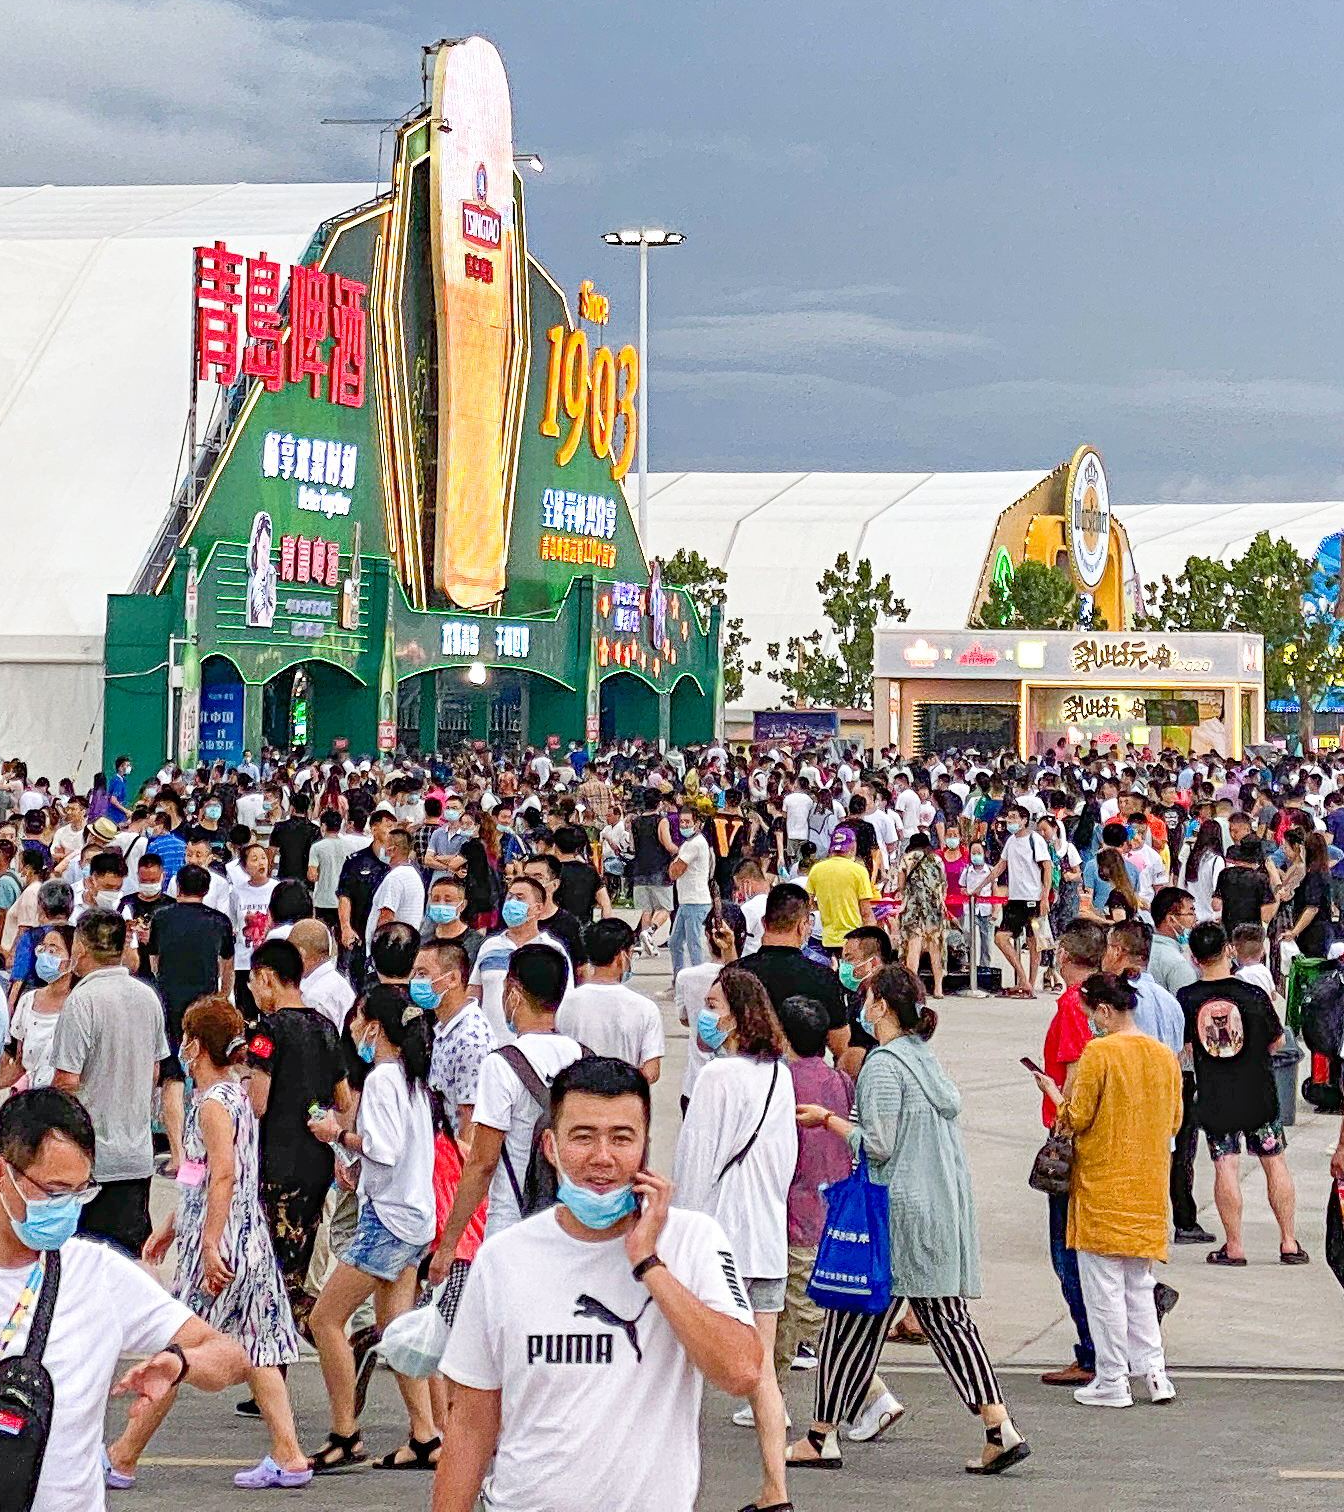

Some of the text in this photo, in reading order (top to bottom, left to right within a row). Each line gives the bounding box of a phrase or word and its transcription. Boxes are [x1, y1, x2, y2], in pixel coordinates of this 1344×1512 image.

[463, 209, 500, 244] TSINGTAO
[193, 241, 368, 409] 青岛啤酒
[540, 324, 639, 481] 1903
[527, 1334, 614, 1365] PUMA
